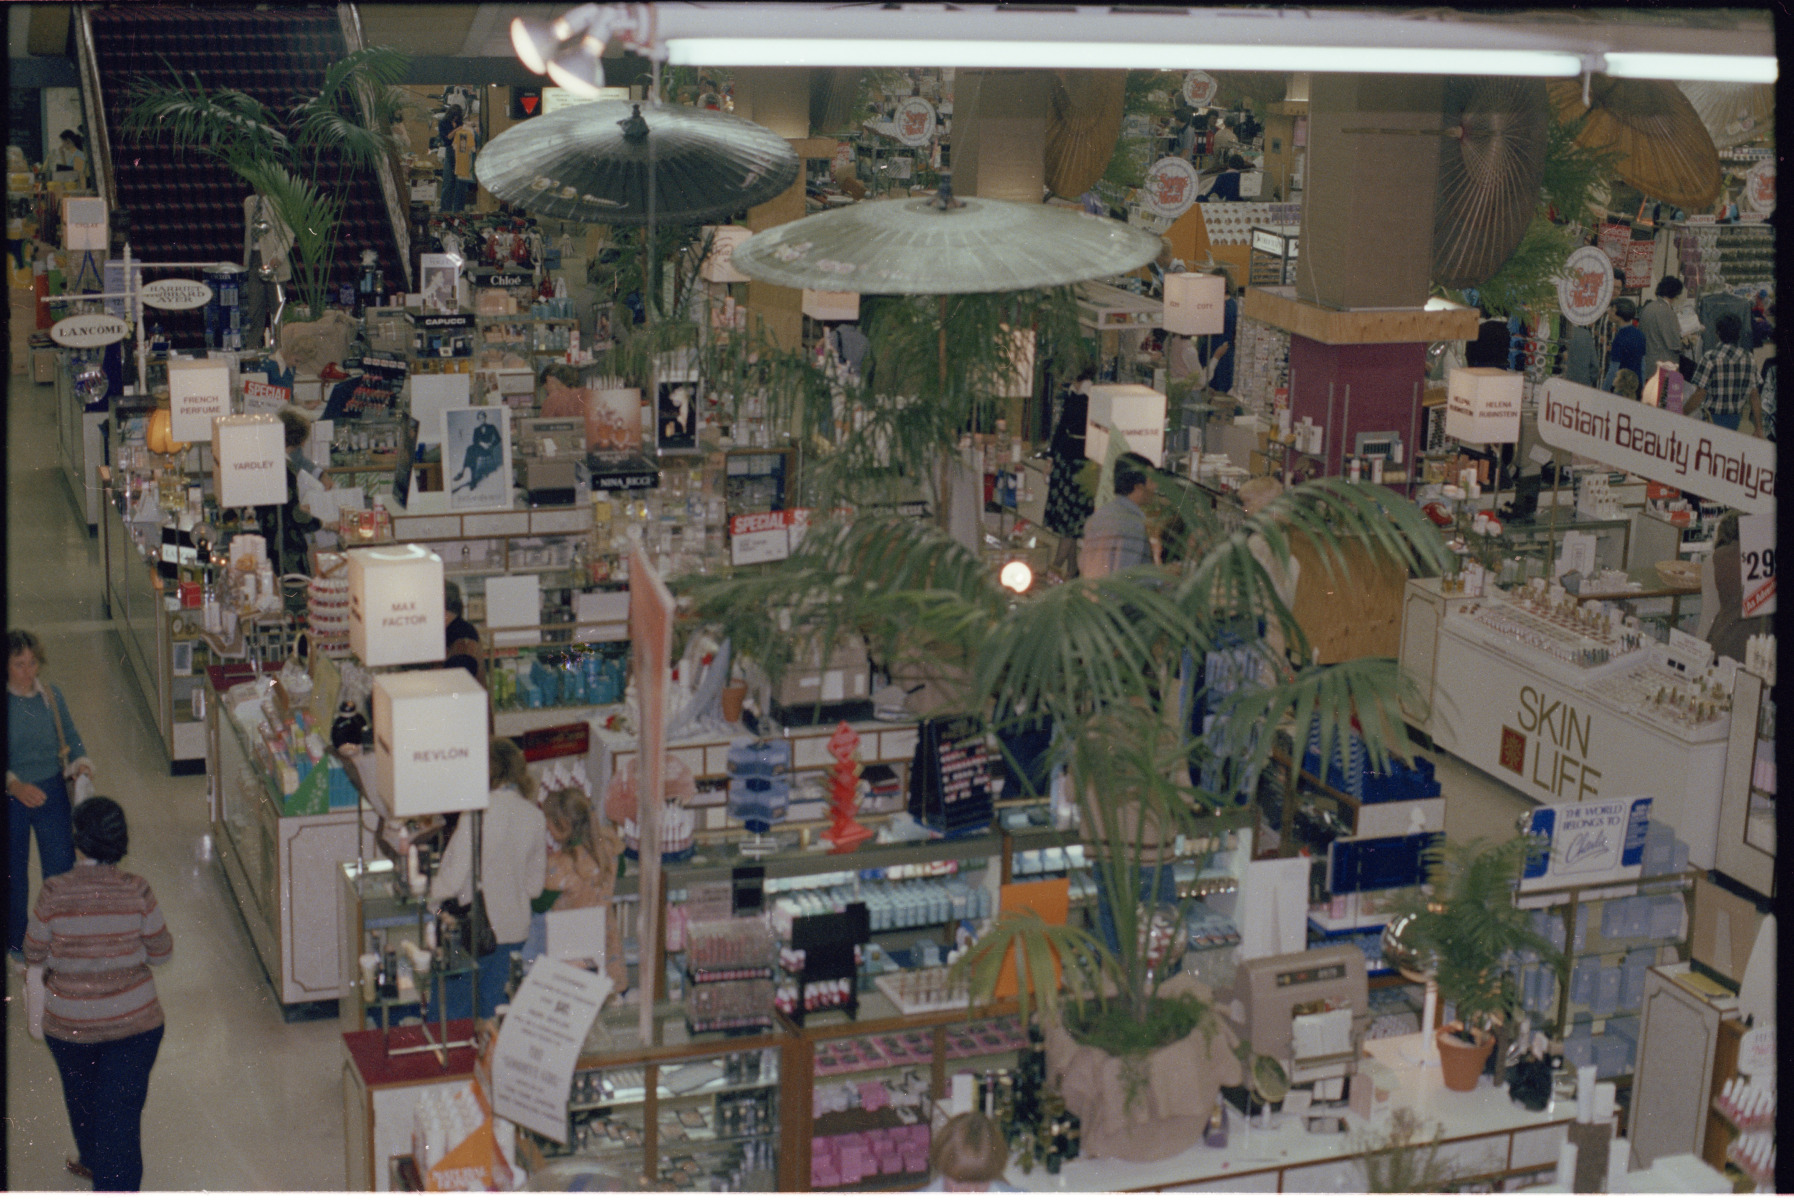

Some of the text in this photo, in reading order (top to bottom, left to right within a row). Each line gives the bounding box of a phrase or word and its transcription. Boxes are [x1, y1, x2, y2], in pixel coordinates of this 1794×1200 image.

[490, 275, 521, 286] Chloé
[425, 317, 466, 326] CAPUCCI
[59, 324, 124, 338] LANCOME
[247, 382, 287, 401] SPECIAL
[181, 405, 220, 414] PERFUME
[1546, 391, 1610, 441] Instant
[1616, 413, 1690, 475] Beauty
[233, 461, 274, 470] YARDLEY
[735, 512, 787, 533] SPECIAL
[392, 602, 416, 612] MAX
[382, 615, 427, 627] FACTOR
[1518, 685, 1591, 759] SKIN
[413, 747, 469, 762] REVLON
[1586, 805, 1622, 816] WORLD
